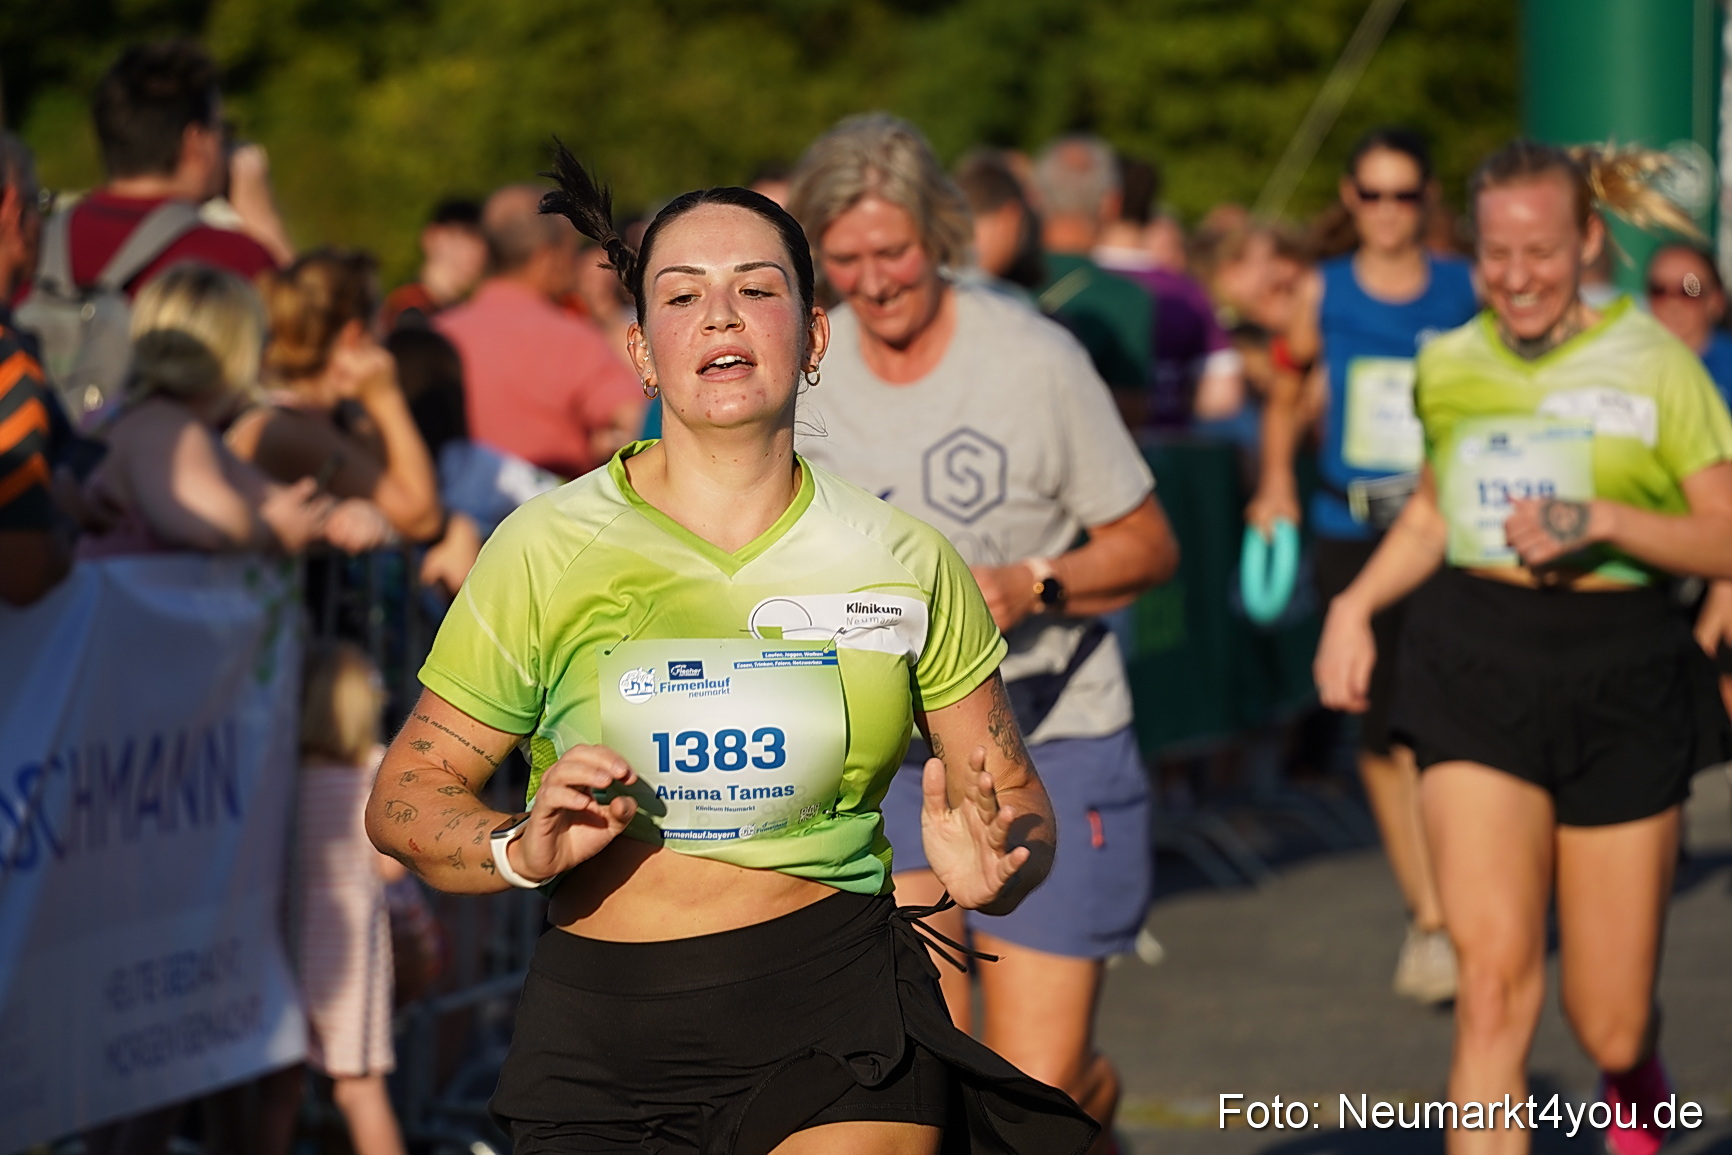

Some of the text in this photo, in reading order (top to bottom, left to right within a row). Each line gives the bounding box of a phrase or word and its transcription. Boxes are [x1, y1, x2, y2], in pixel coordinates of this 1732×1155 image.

[846, 602, 902, 616] Klinikum
[660, 677, 731, 693] Firmenlauf
[688, 687, 730, 699] neumarkt
[652, 727, 787, 773] 1383
[655, 784, 795, 801] Ariana Tamas
[663, 830, 736, 841] firmenlauf.bayern
